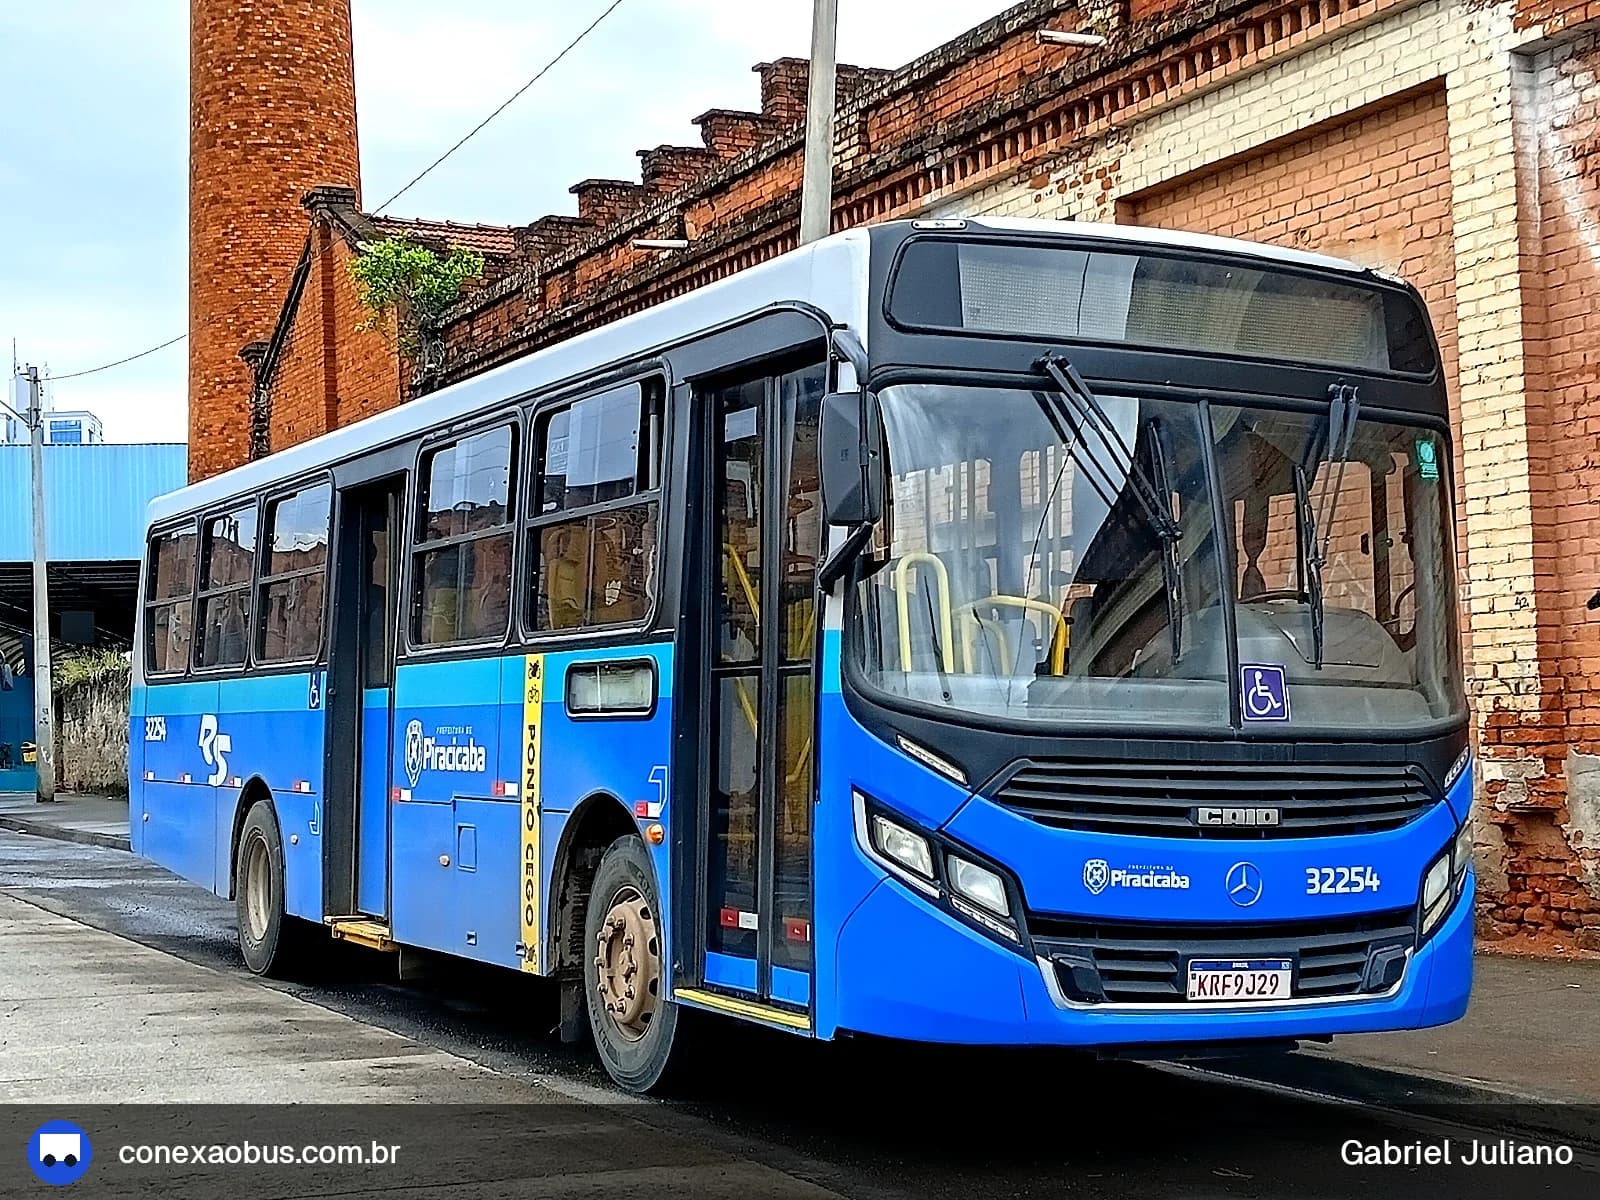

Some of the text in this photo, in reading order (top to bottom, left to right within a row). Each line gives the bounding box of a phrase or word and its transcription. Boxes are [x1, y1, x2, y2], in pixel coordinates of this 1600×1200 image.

[144, 716, 167, 742] 32254
[422, 736, 486, 772] Piracicaba
[525, 724, 536, 927] PONTO CEGO
[1198, 807, 1279, 825] CAIO
[1110, 869, 1191, 889] Piracicaba
[1305, 866, 1381, 895] 32254
[1197, 973, 1280, 997] KRF9J29
